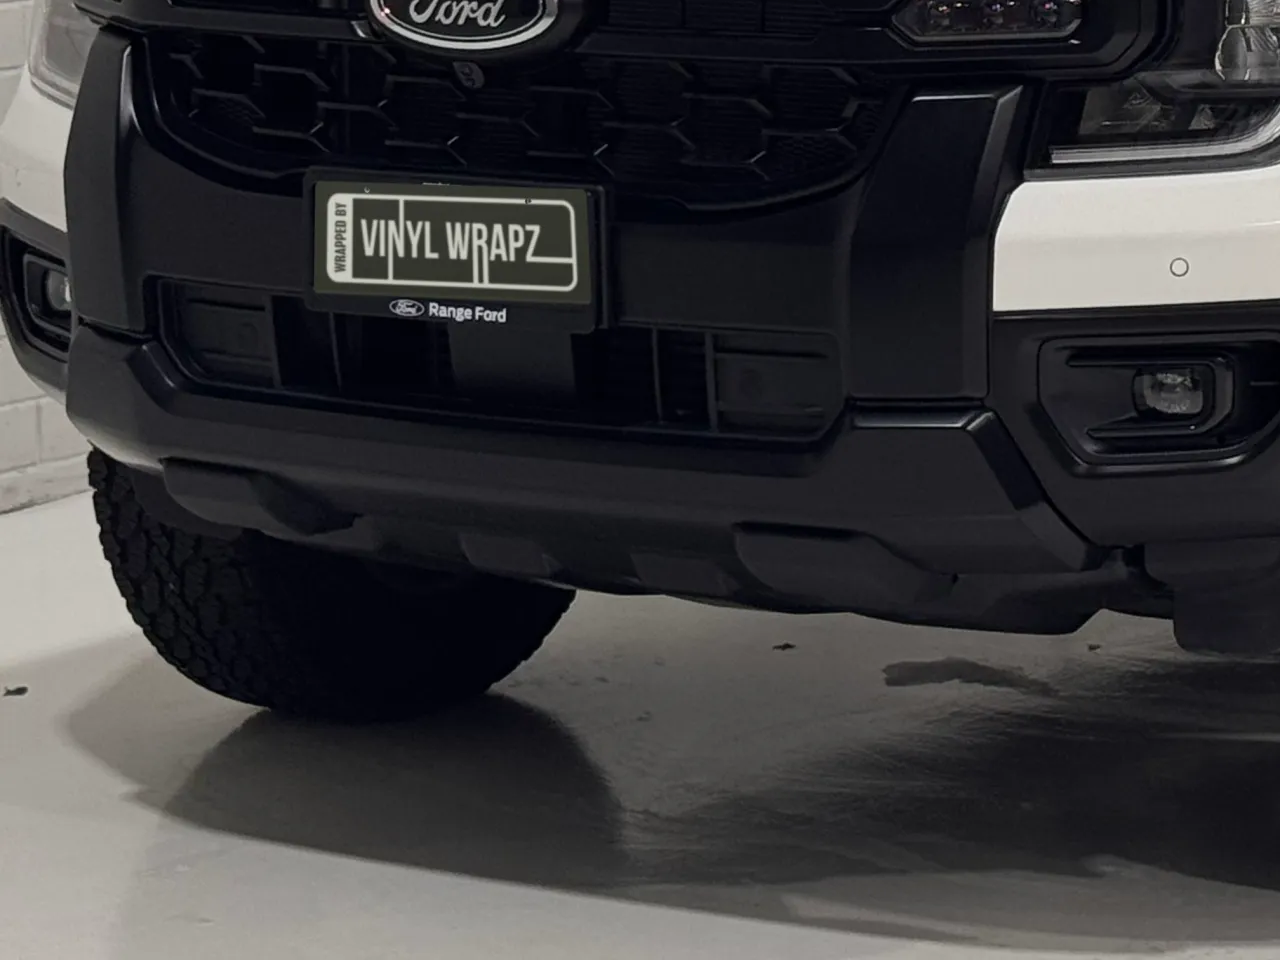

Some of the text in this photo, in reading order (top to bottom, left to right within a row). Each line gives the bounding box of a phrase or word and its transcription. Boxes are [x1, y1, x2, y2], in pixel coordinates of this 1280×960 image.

[334, 202, 347, 273] WRAPPED BY
[360, 216, 545, 276] VINYL WRAPZ
[429, 302, 472, 321] Range
[475, 306, 507, 322] Ford
